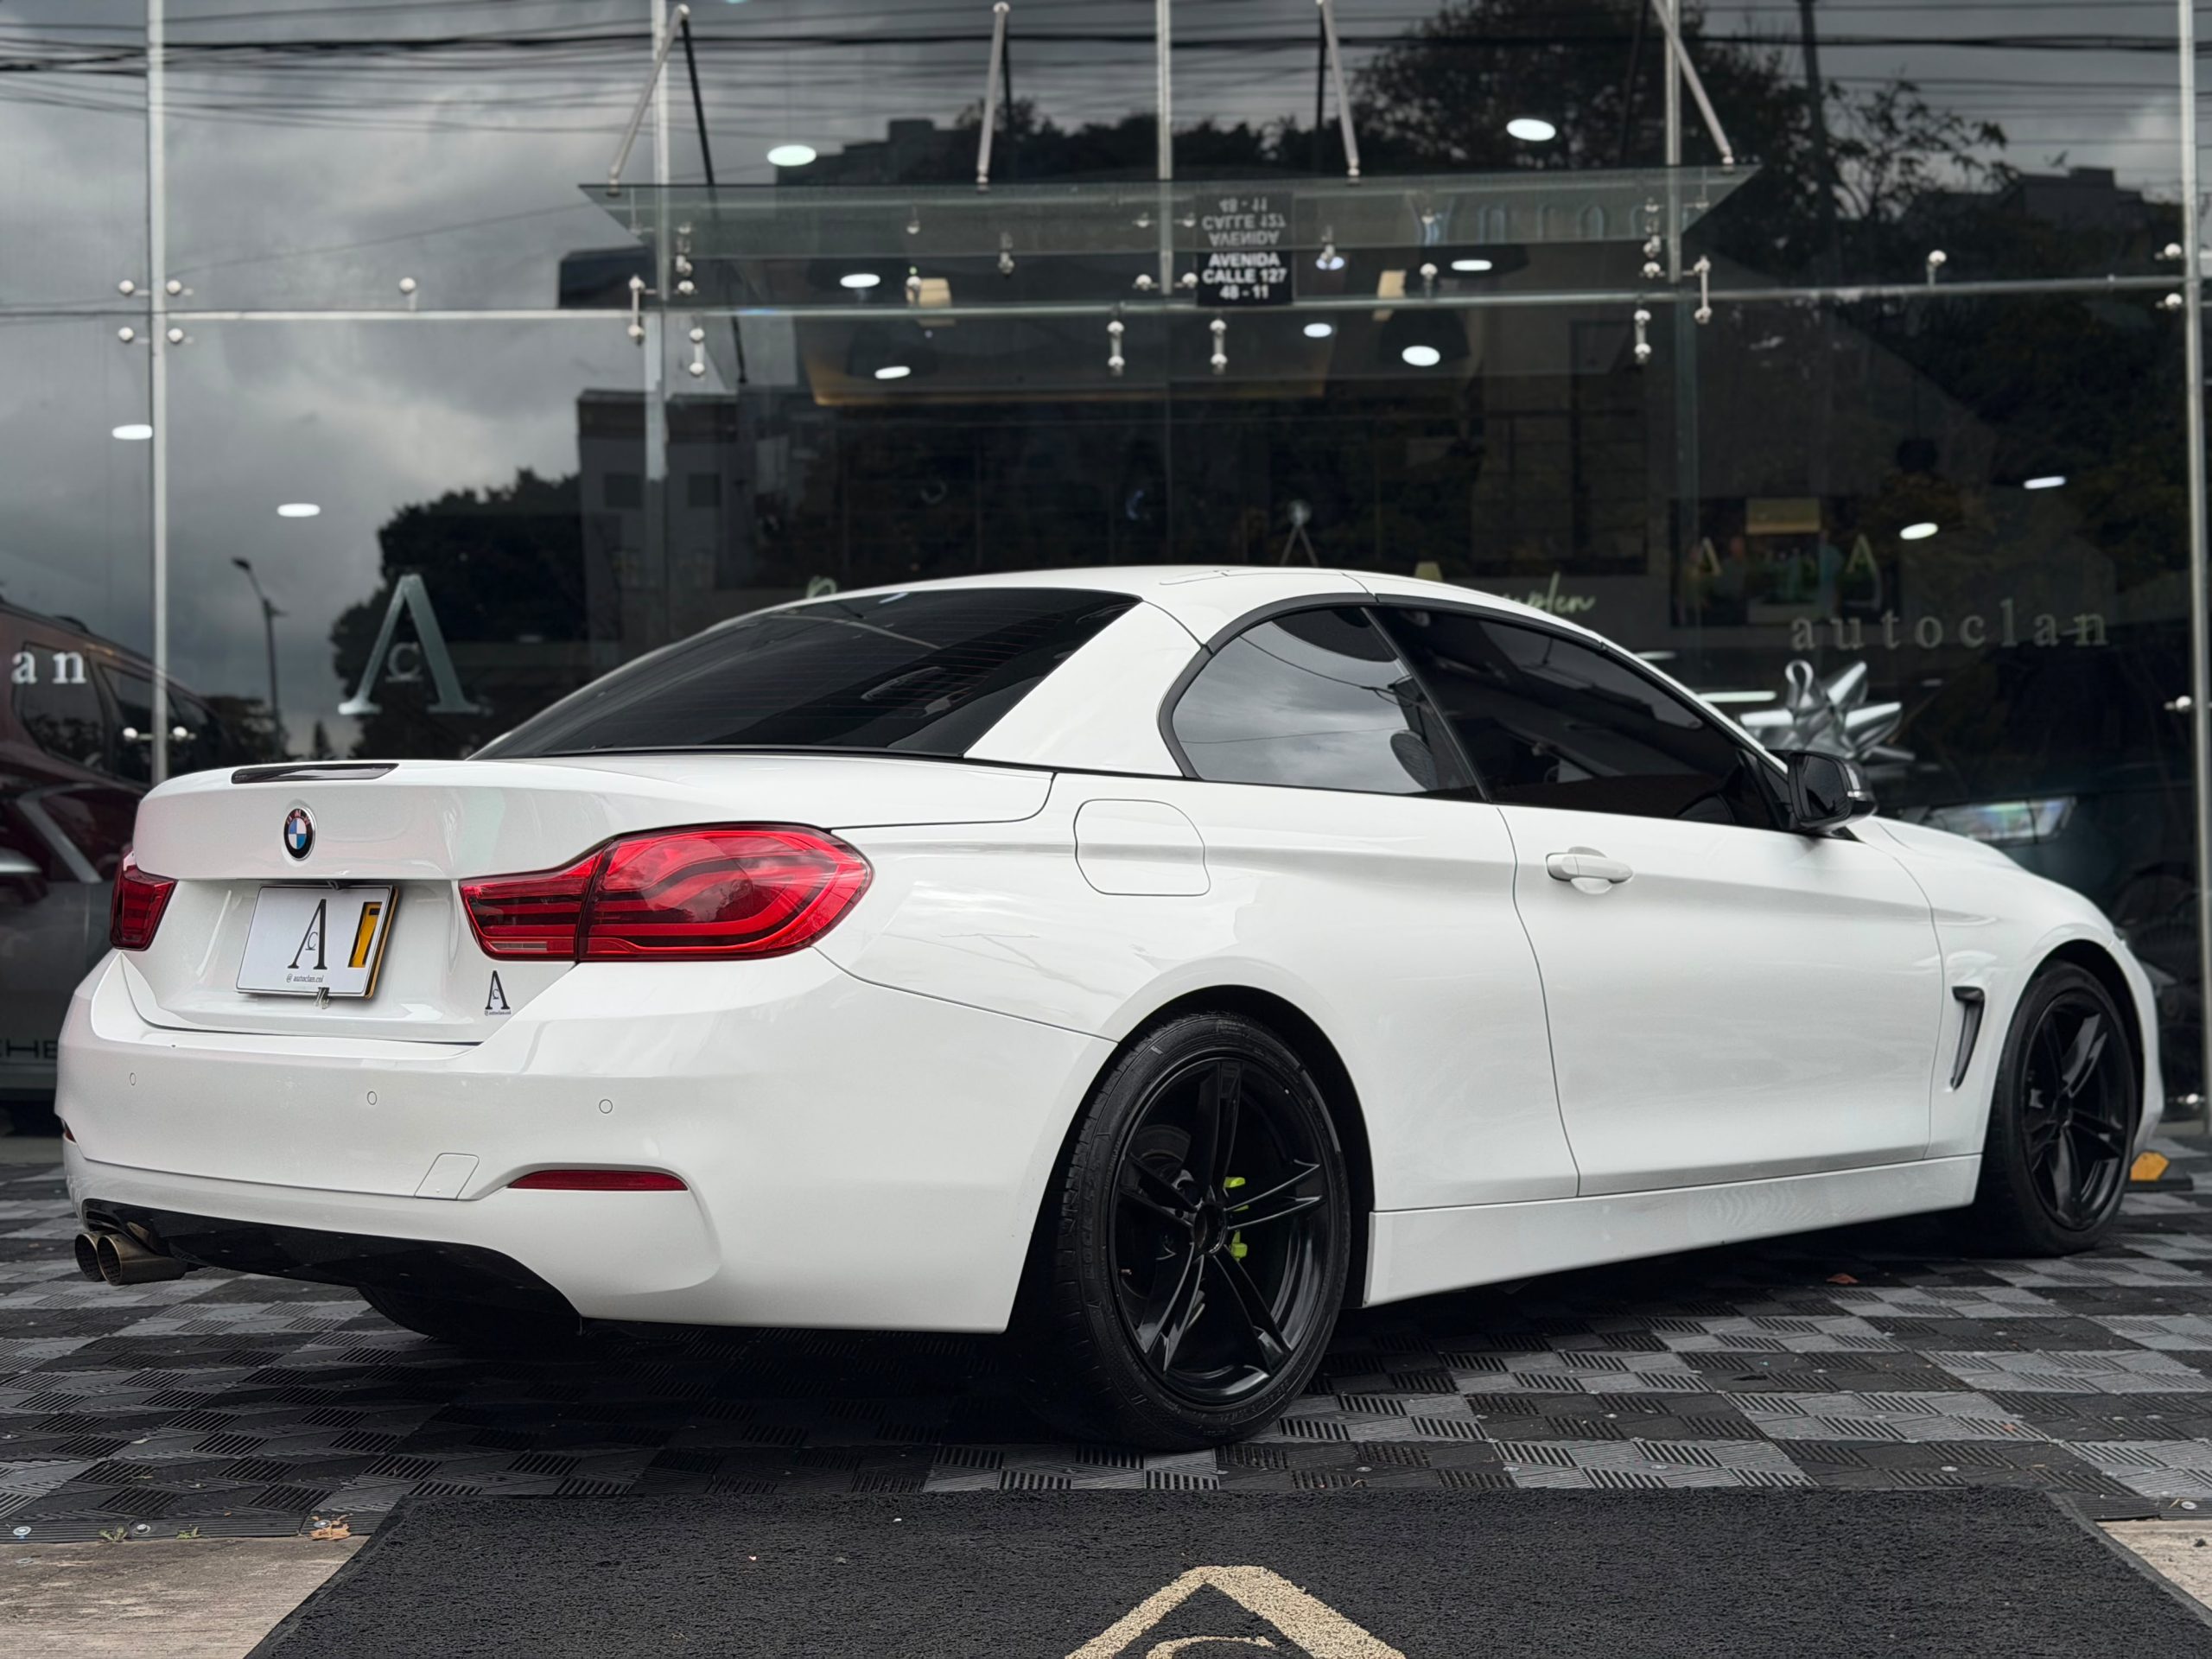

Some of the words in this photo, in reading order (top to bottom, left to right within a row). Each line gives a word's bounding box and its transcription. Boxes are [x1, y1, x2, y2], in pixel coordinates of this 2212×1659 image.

[1209, 252, 1281, 267] AVENIDA
[1202, 269, 1255, 283] CALLE
[1260, 268, 1287, 283] 127
[1219, 285, 1239, 299] 48
[1252, 284, 1268, 299] 11
[1790, 598, 2108, 652] autoclan
